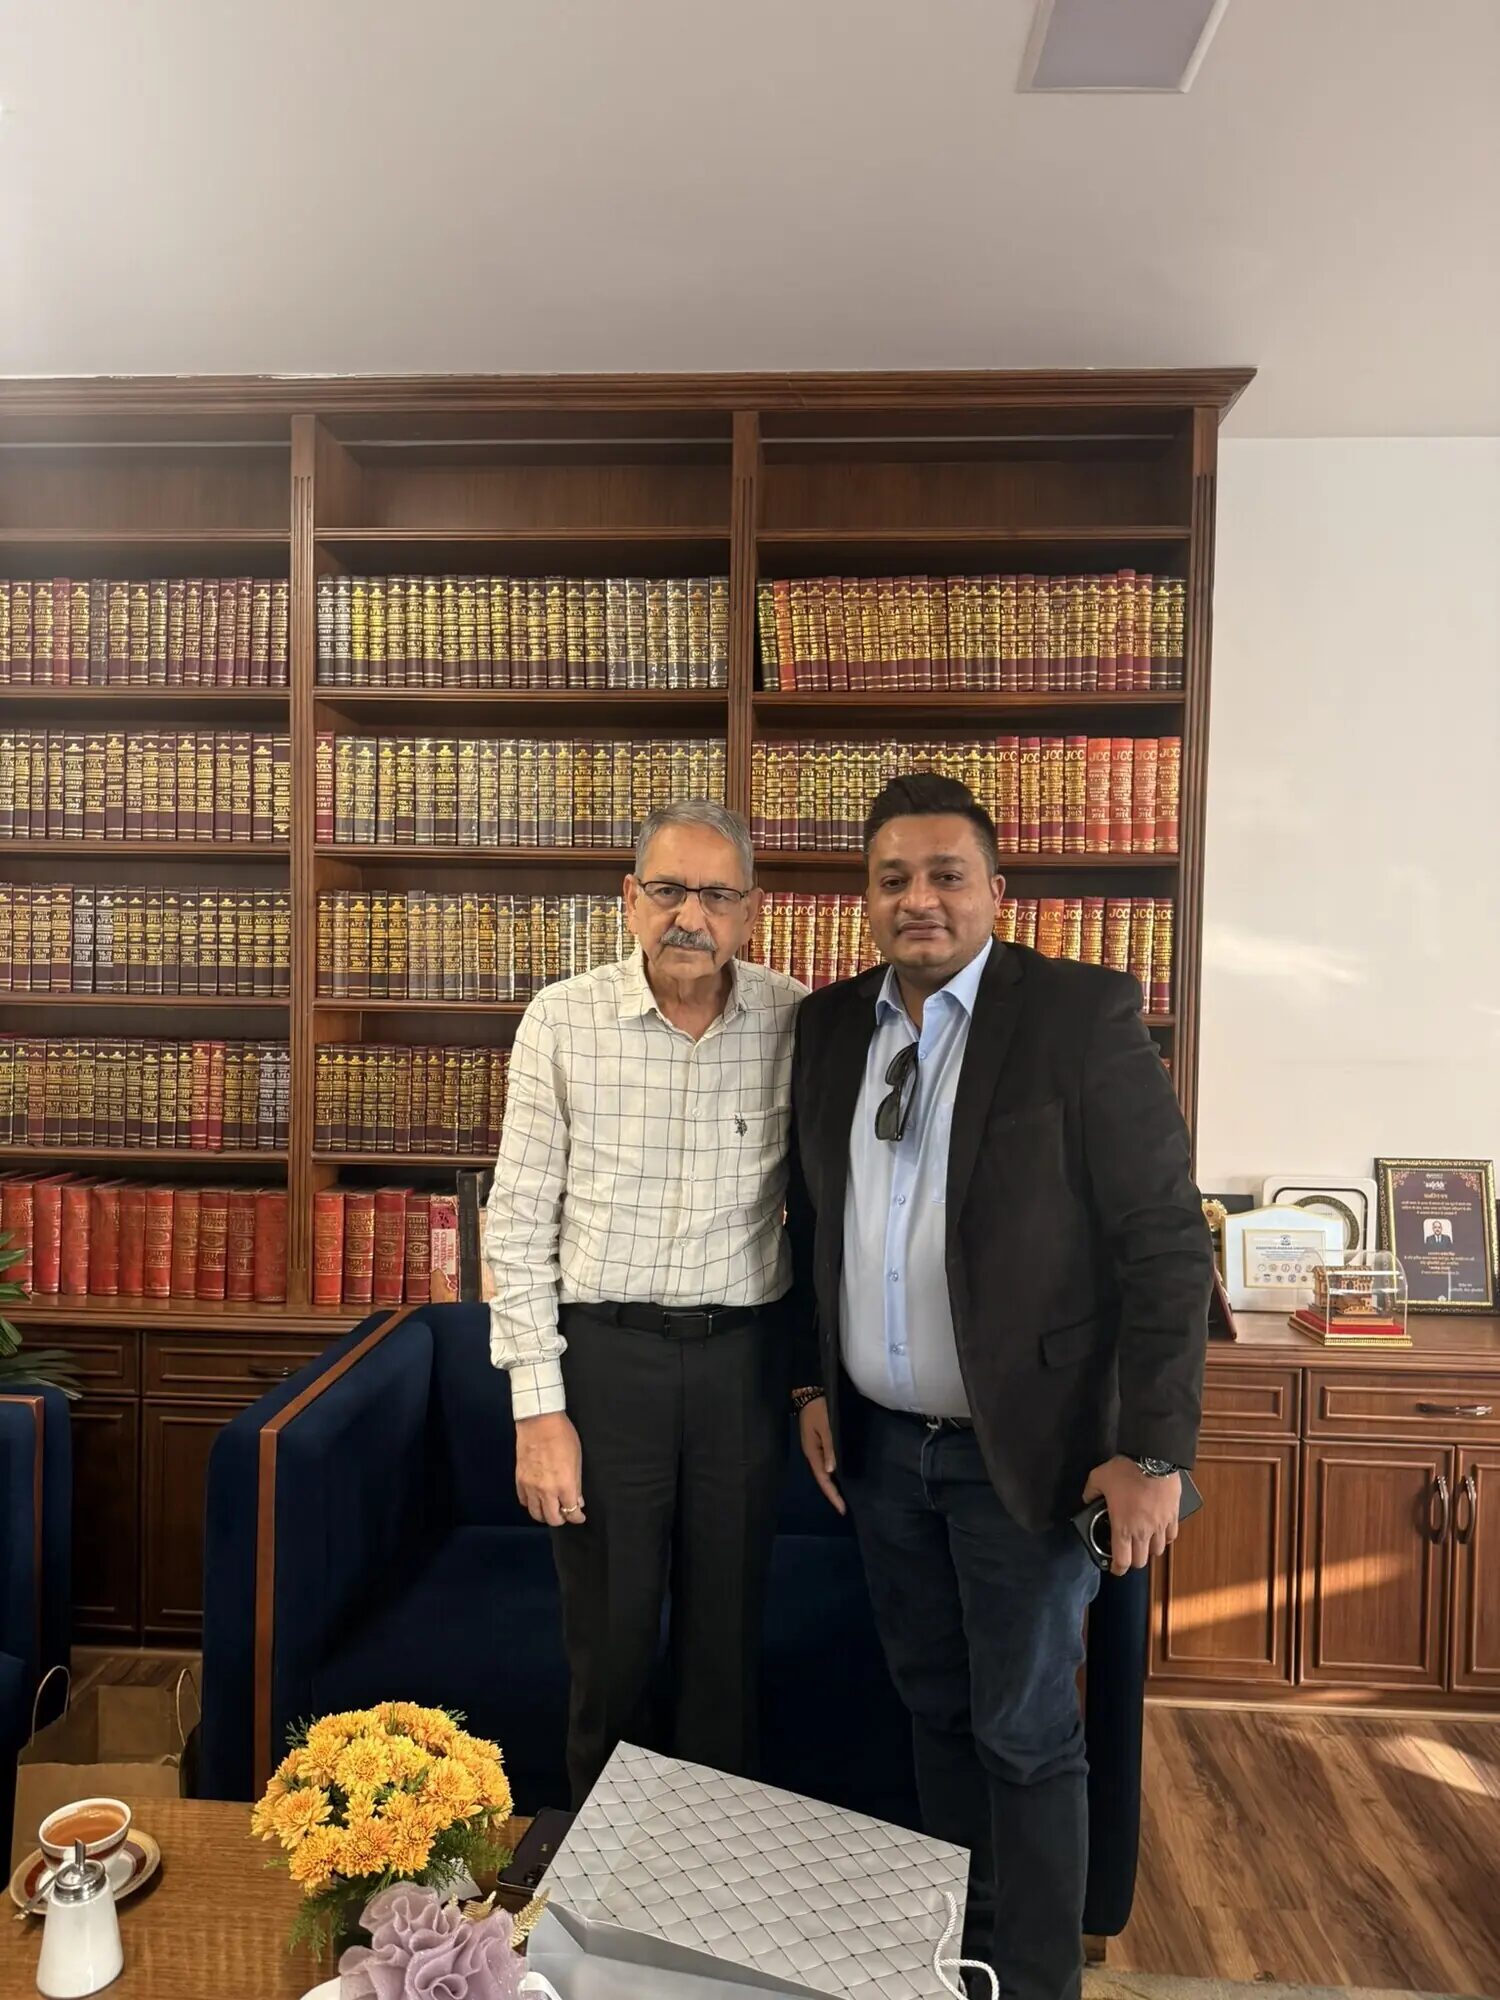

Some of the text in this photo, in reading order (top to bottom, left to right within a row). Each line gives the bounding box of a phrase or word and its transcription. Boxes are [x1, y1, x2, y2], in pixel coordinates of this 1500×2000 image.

[997, 750, 1017, 762] JCC
[1020, 753, 1040, 764] JCC
[1043, 749, 1063, 761] JCC
[1064, 749, 1085, 761] JCC
[1089, 751, 1110, 762] JCC
[1112, 750, 1133, 761] JCC
[1136, 751, 1156, 761] JCC
[1159, 748, 1180, 758] JCC
[774, 905, 793, 916] JCC
[795, 905, 814, 916] JCC
[819, 906, 839, 917] JCC
[842, 906, 862, 917] JCC
[1002, 909, 1015, 919] CC
[1064, 909, 1082, 921] JCC
[1085, 909, 1104, 920] JCC
[1109, 908, 1130, 919] JCC
[1133, 908, 1153, 920] JCC
[1155, 909, 1174, 921] JCC
[75, 916, 91, 924] APEX
[1041, 912, 1061, 921] JCC
[447, 1243, 455, 1260] THE
